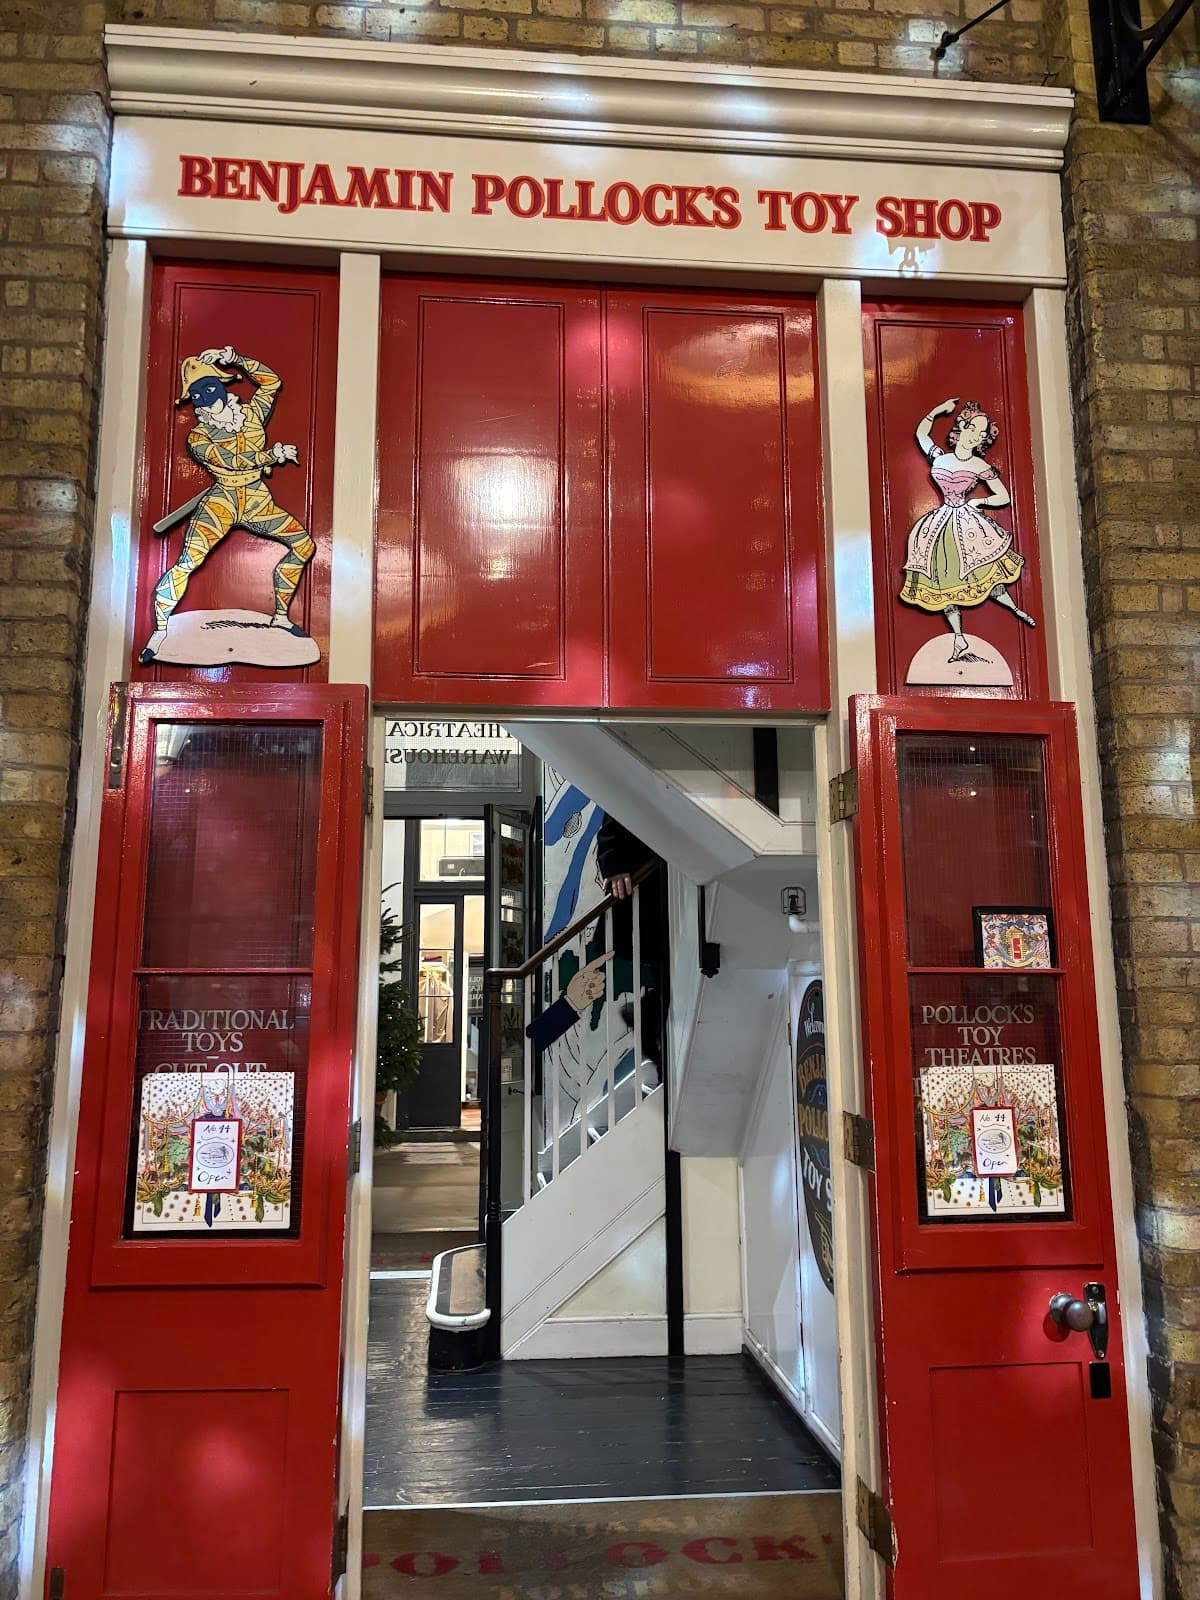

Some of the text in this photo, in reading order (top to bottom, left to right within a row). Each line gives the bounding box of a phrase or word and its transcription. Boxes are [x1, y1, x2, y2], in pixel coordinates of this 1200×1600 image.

[177, 154, 1002, 242] BENJAMIN POLLOCK'S TOY SHOP
[921, 1004, 1034, 1024] POLLOCK'S
[182, 1031, 243, 1052] TOYS
[958, 1026, 1004, 1046] TOY
[924, 1047, 1036, 1067] THEATRES
[803, 1146, 823, 1200] TOY
[983, 1158, 1008, 1170] Open
[197, 1170, 229, 1184] Open
